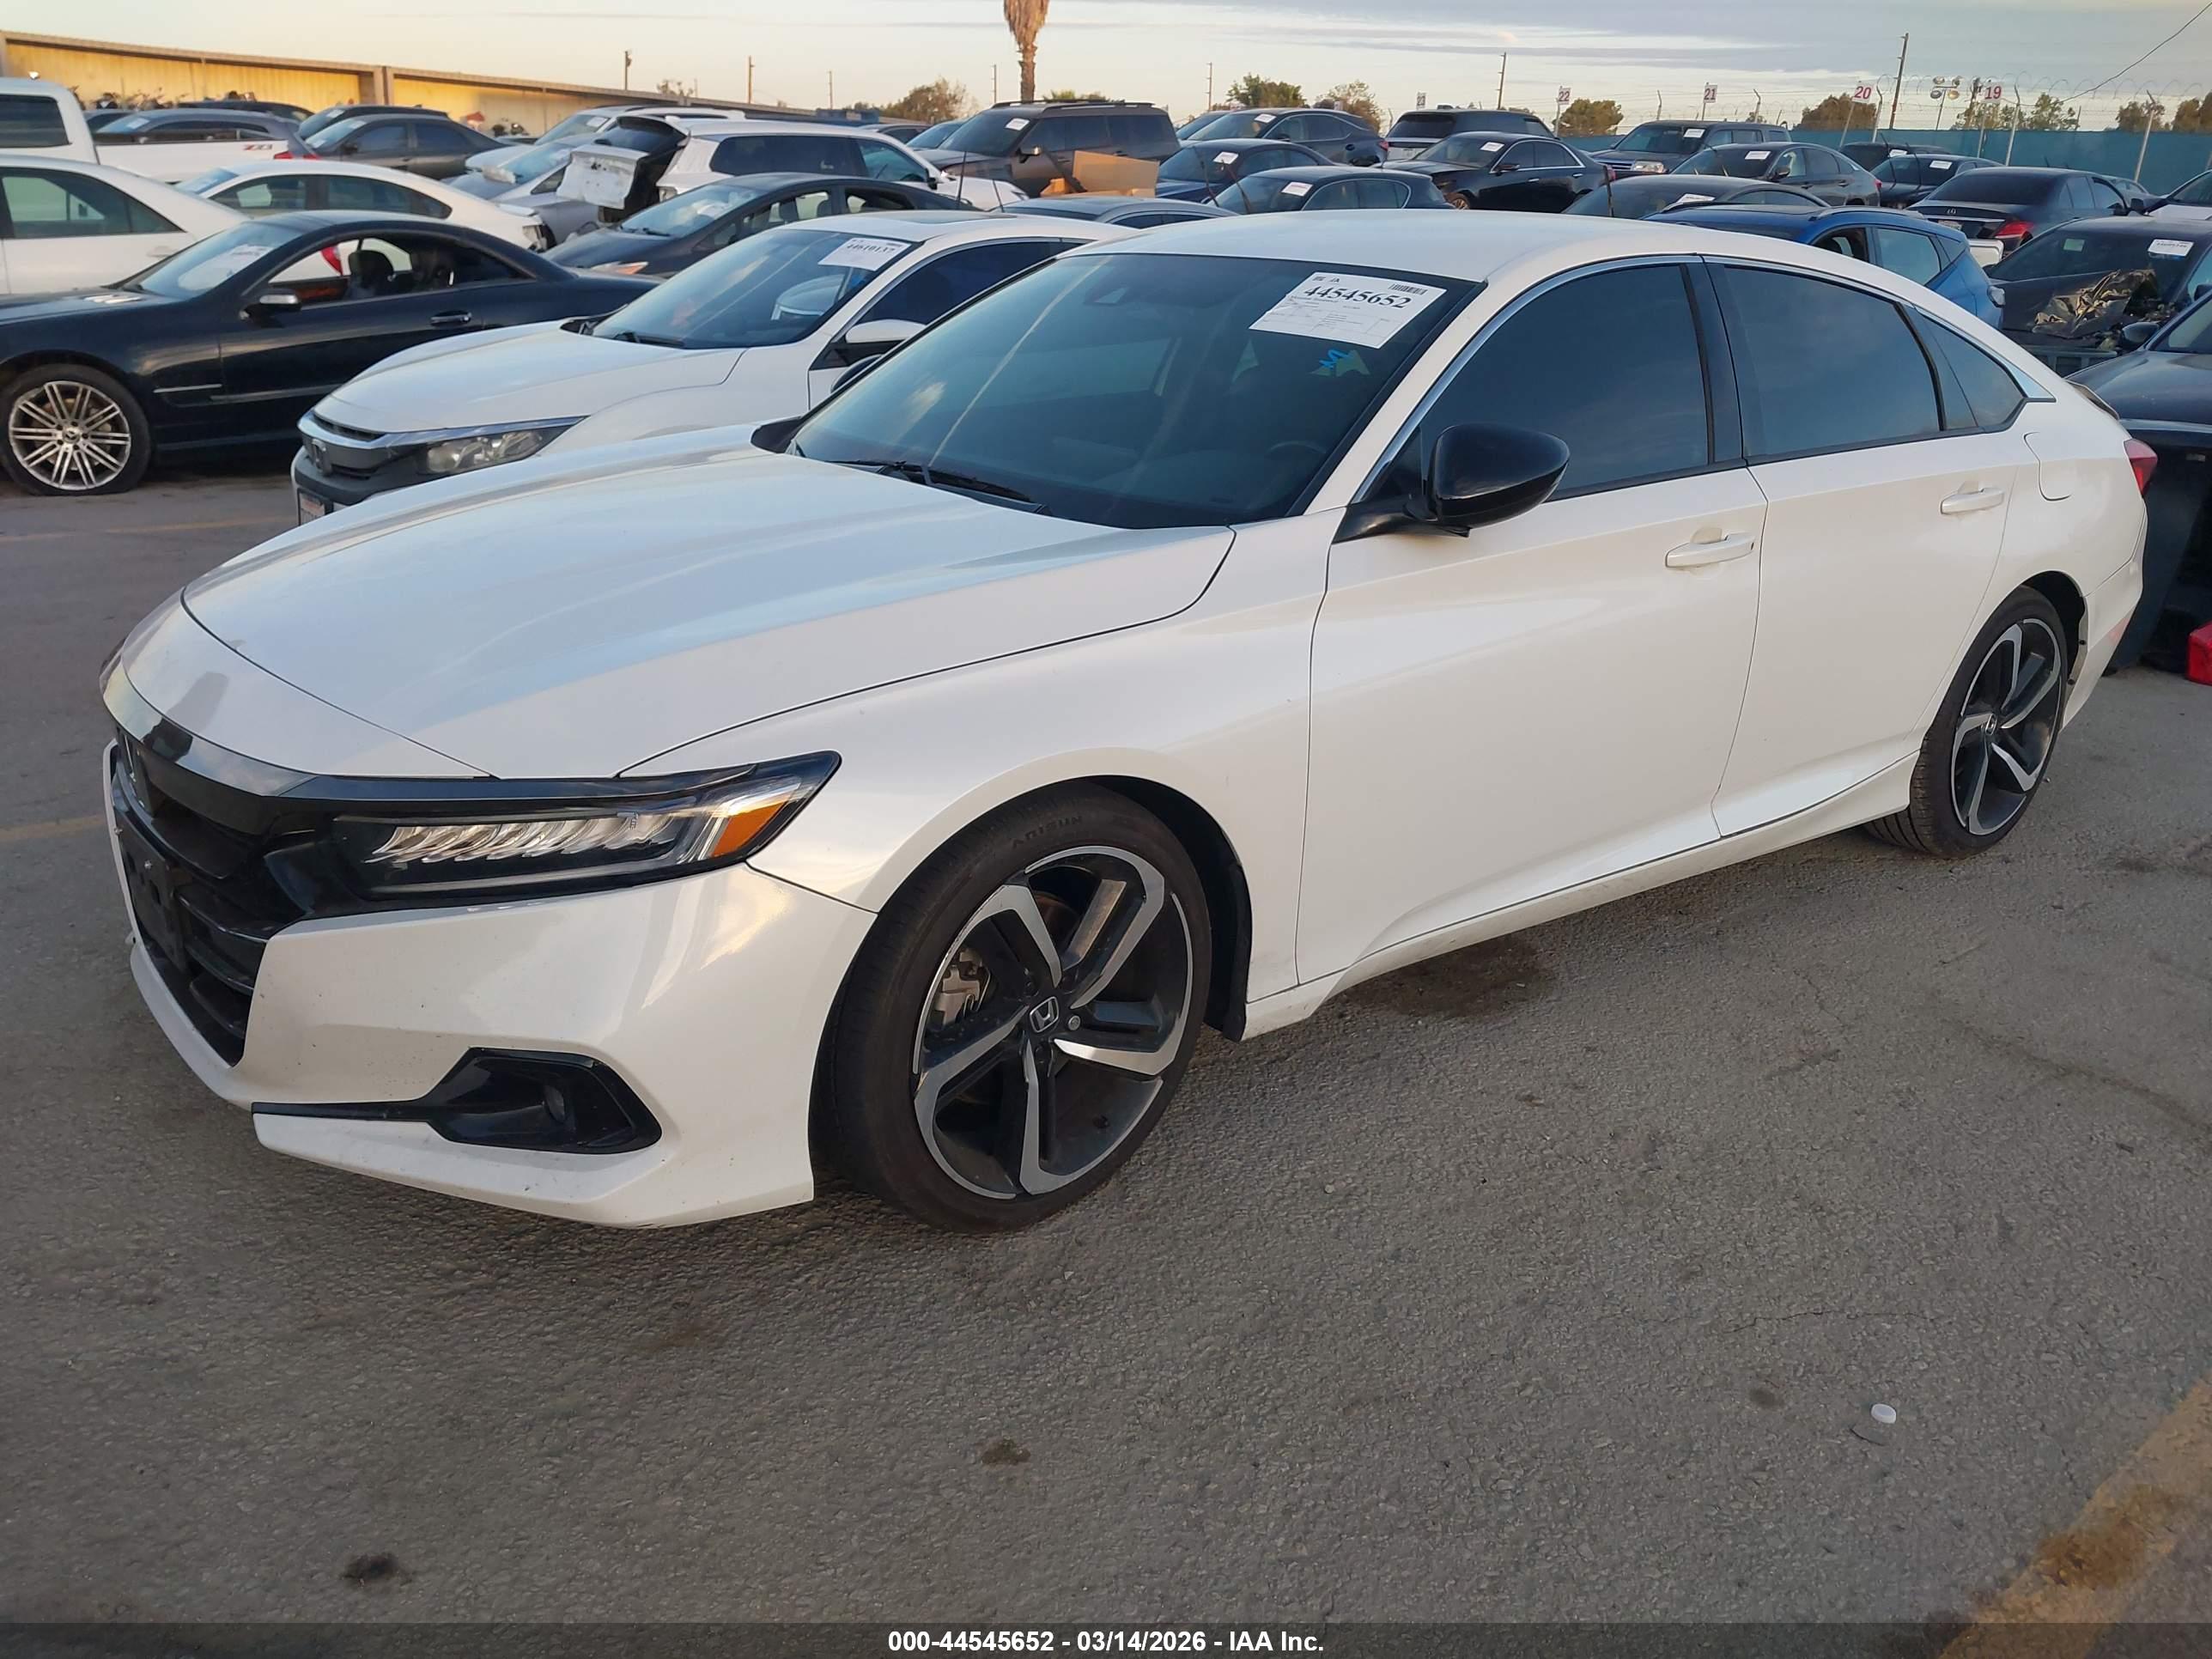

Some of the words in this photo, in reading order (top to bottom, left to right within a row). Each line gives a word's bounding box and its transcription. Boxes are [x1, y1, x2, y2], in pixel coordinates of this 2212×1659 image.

[1559, 90, 1571, 102] 22
[1704, 88, 1717, 100] 21
[1853, 86, 1872, 100] 20
[1984, 86, 2002, 100] 19
[1304, 285, 1413, 309] 44545652
